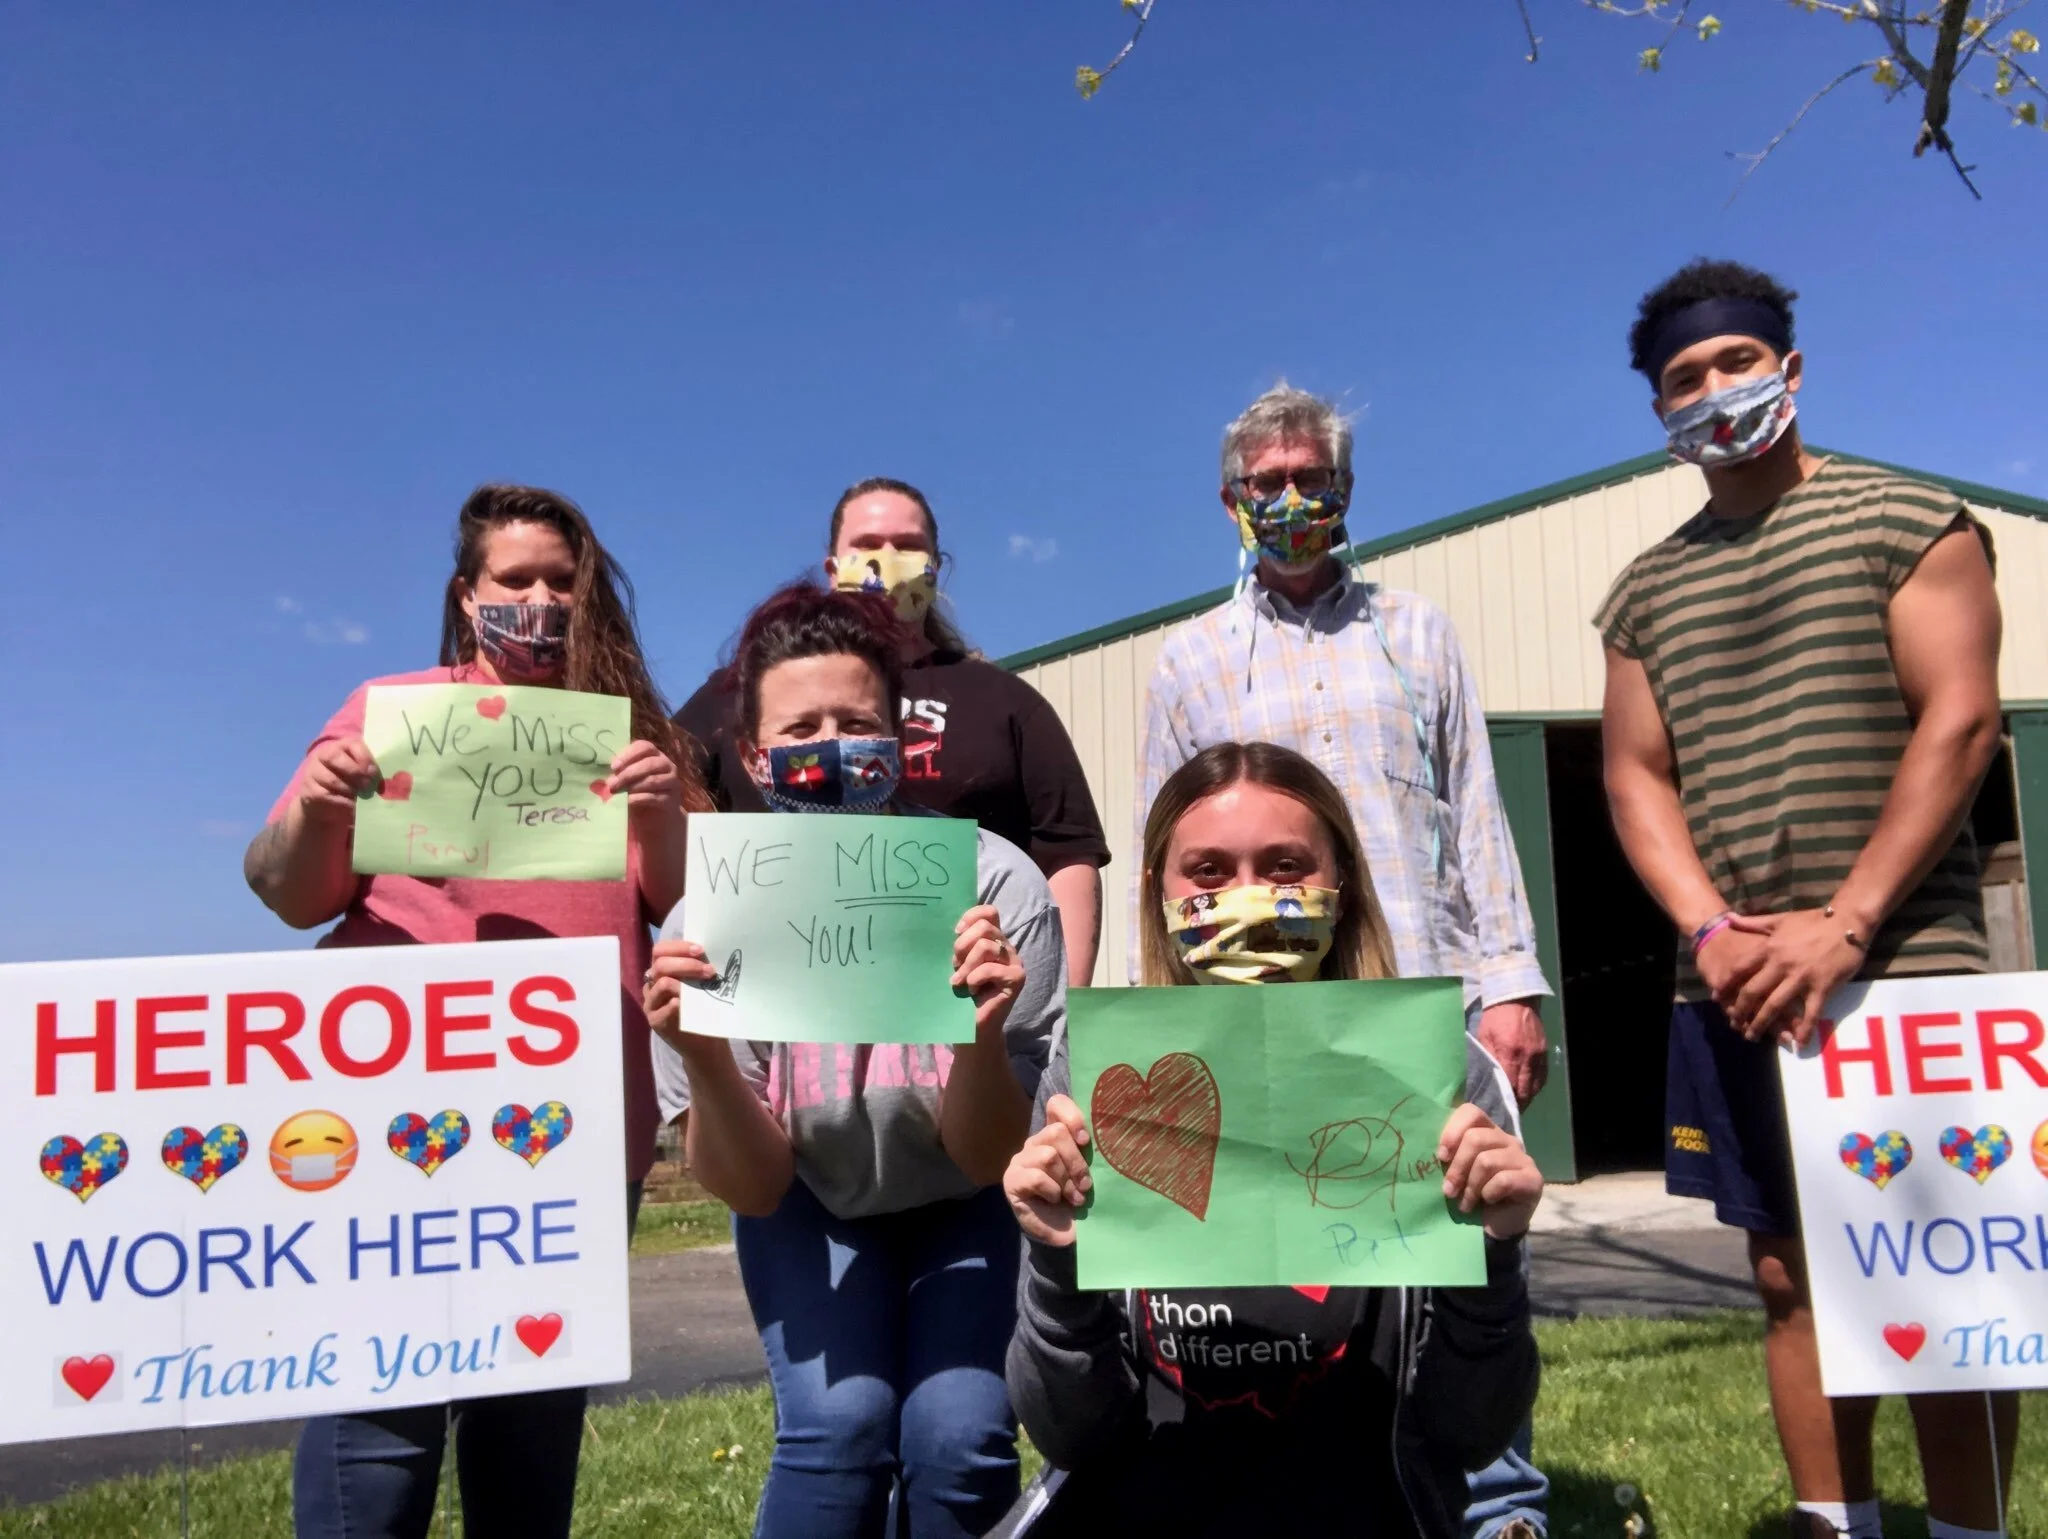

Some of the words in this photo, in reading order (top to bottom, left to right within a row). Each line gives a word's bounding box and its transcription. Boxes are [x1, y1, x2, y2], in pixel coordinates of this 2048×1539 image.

[401, 704, 490, 756] We
[511, 714, 617, 766] Miss
[507, 803, 590, 826] Teresa
[699, 836, 793, 896] WE
[835, 833, 950, 893] MISS
[34, 975, 581, 1097] HEROES
[1819, 1008, 2048, 1099] HER
[33, 1220, 317, 1306] WORK
[348, 1199, 581, 1281] HERE
[1844, 1214, 2048, 1278] WOR
[133, 1331, 340, 1405] Thank
[366, 1324, 502, 1393] You!
[1158, 1332, 1314, 1367] different
